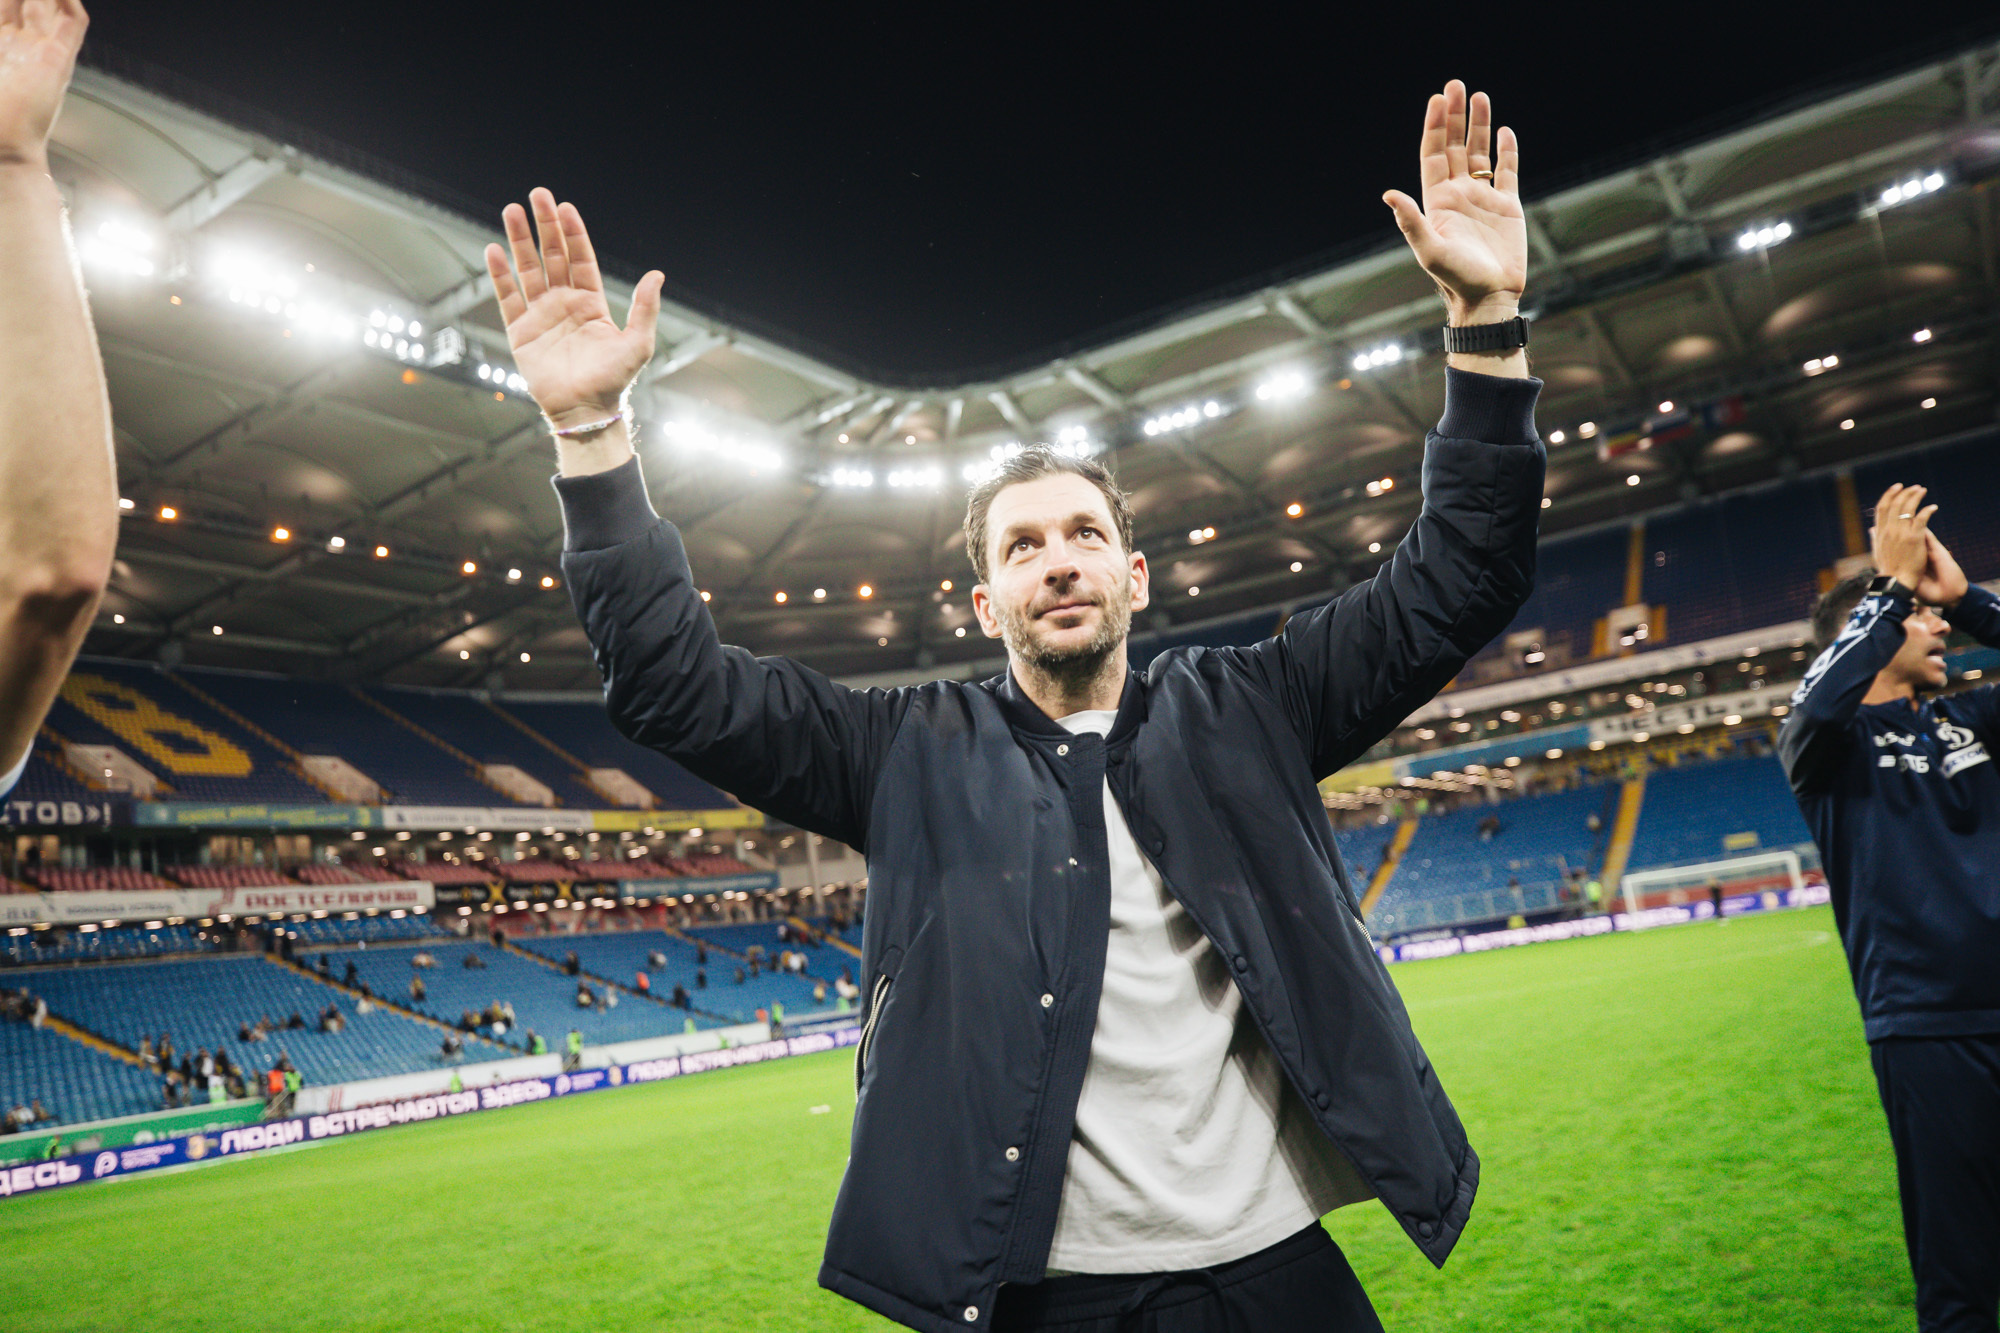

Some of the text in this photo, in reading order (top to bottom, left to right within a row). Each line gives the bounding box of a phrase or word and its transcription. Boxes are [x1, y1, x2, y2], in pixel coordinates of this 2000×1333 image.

[220, 1120, 304, 1155] ЛЮДИ
[309, 1090, 478, 1139] ВСТРЕЧАЮТСЯ
[481, 1079, 551, 1108] ЗДЕСЬ
